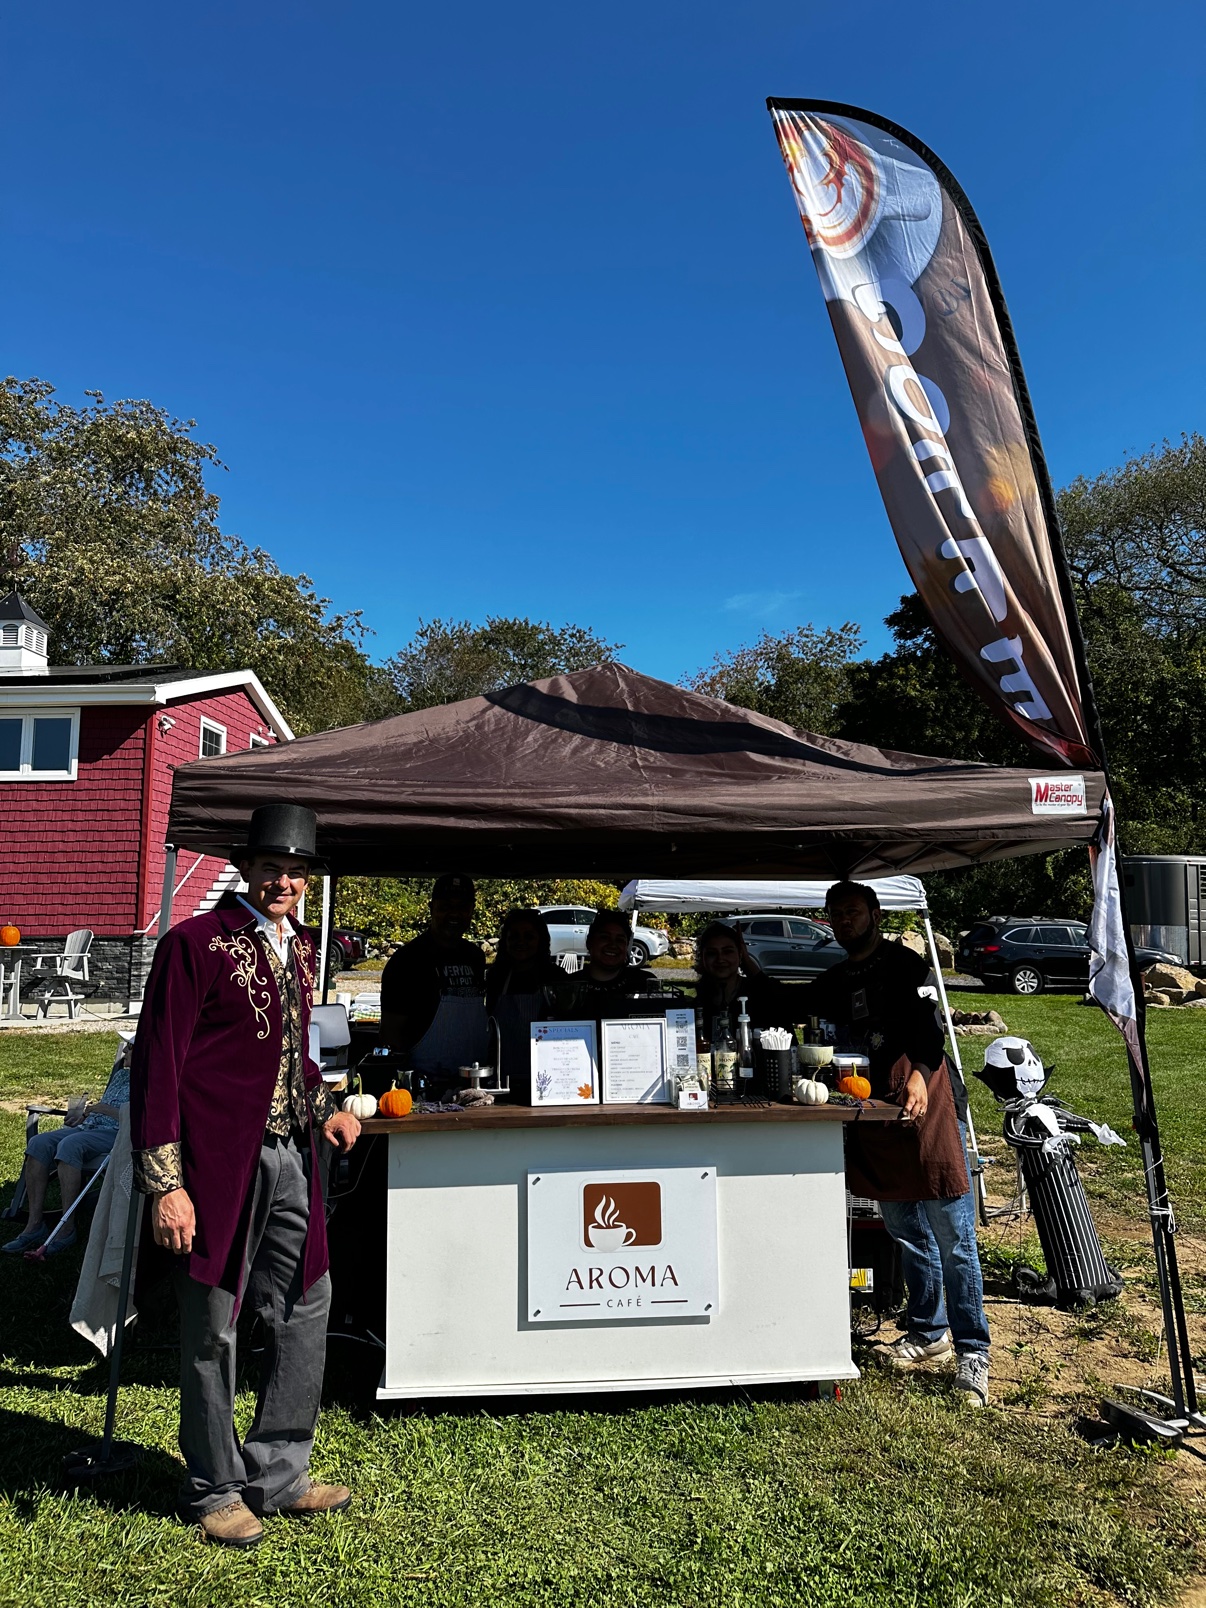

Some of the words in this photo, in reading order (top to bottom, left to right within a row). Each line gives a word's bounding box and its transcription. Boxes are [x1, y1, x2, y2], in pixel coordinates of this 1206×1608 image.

[1035, 782, 1073, 803] Master
[1049, 792, 1083, 806] Canopy
[565, 1264, 679, 1291] AROMA
[606, 1295, 642, 1308] CAFÉ
